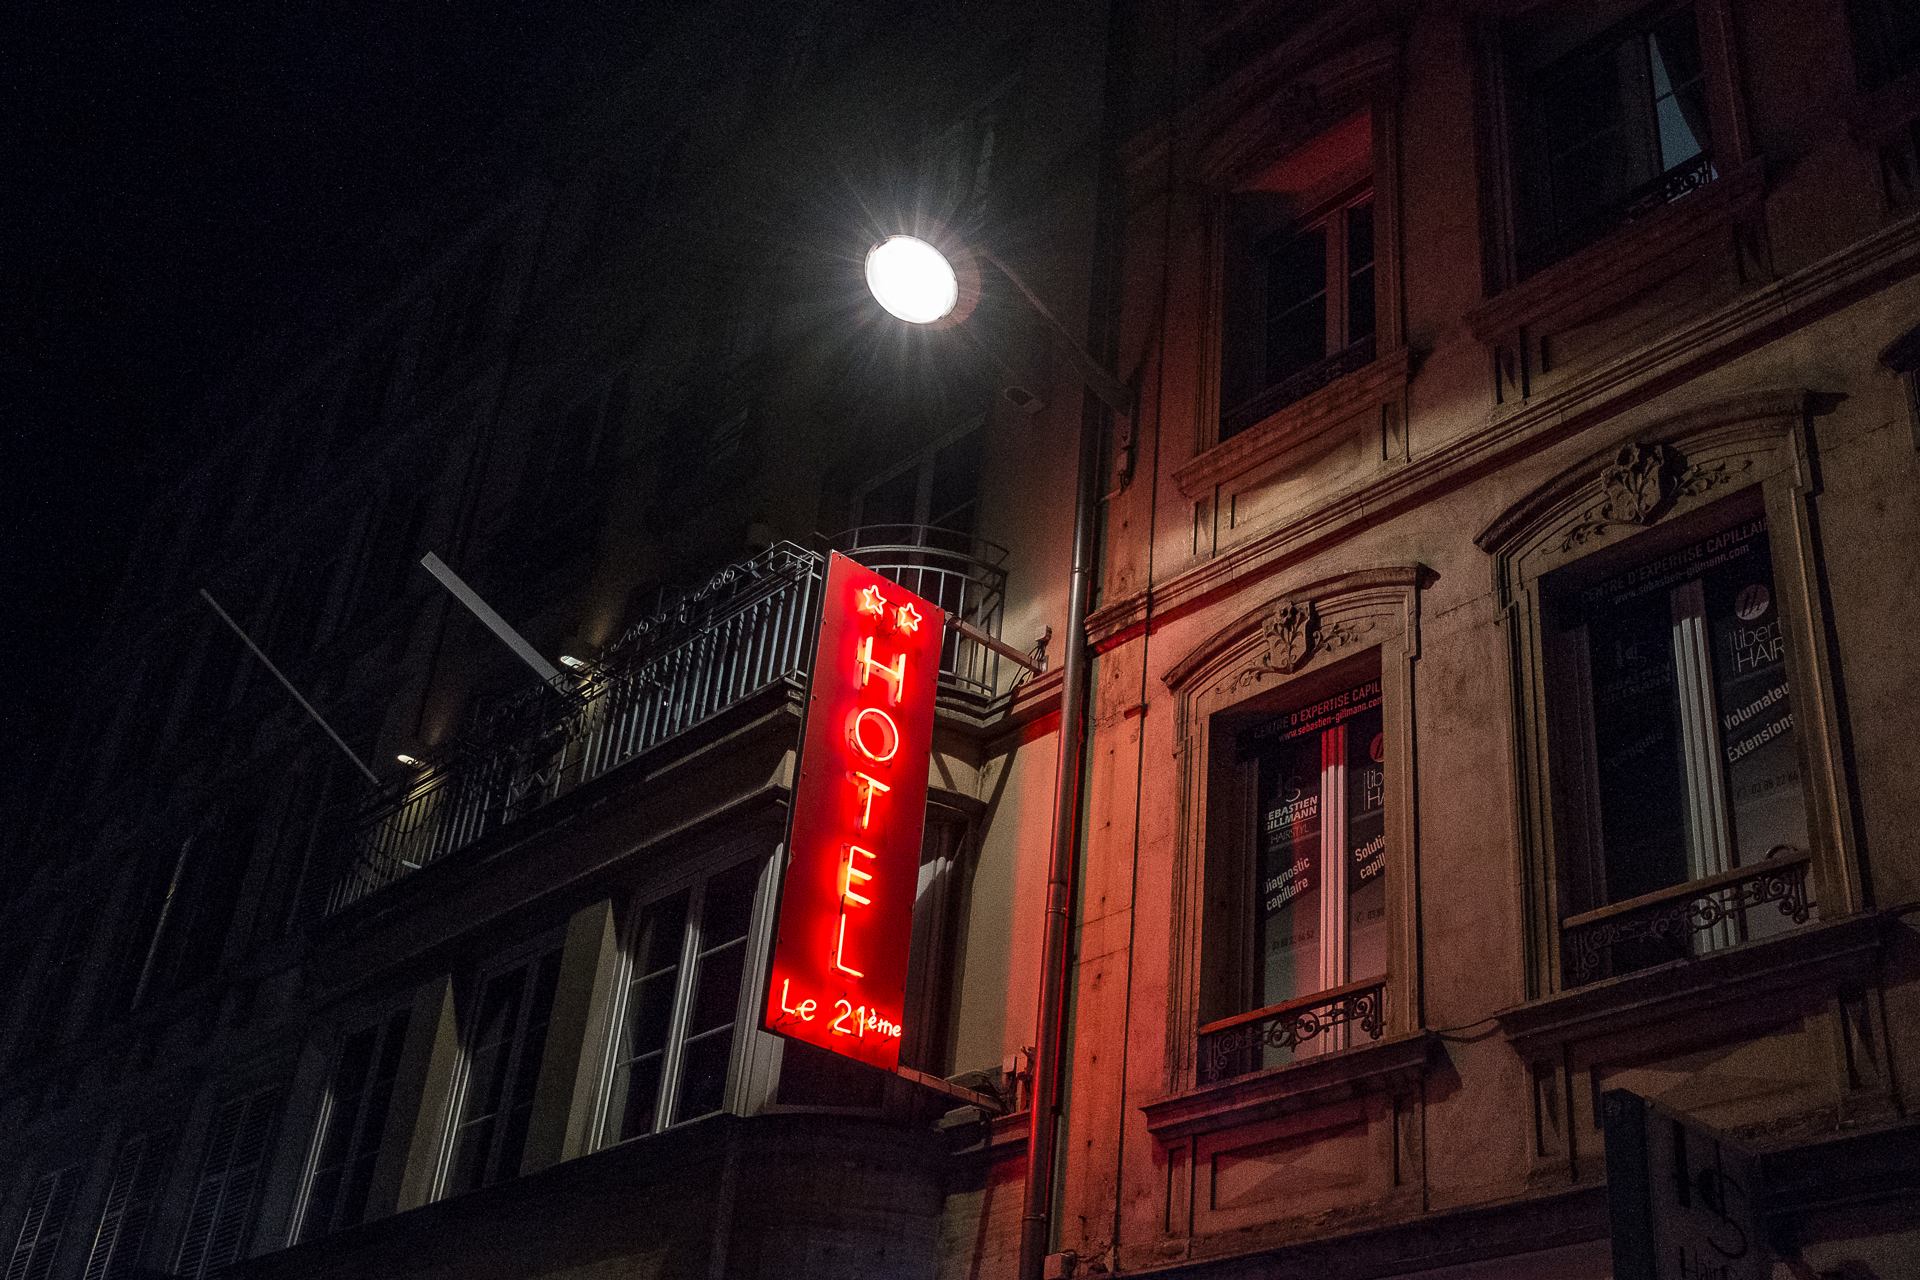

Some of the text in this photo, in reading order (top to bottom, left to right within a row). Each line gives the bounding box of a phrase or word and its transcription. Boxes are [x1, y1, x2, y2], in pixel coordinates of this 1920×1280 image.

[1737, 636, 1785, 673] HAIR
[1290, 692, 1350, 726] D'EXPERTISE
[1352, 681, 1381, 702] CAPIL
[1724, 682, 1790, 731] Volumateu
[1726, 713, 1795, 763] Extensions
[836, 634, 907, 978] HOTEL
[1266, 877, 1309, 911] capillaire
[781, 978, 902, 1038] Le 21ème
